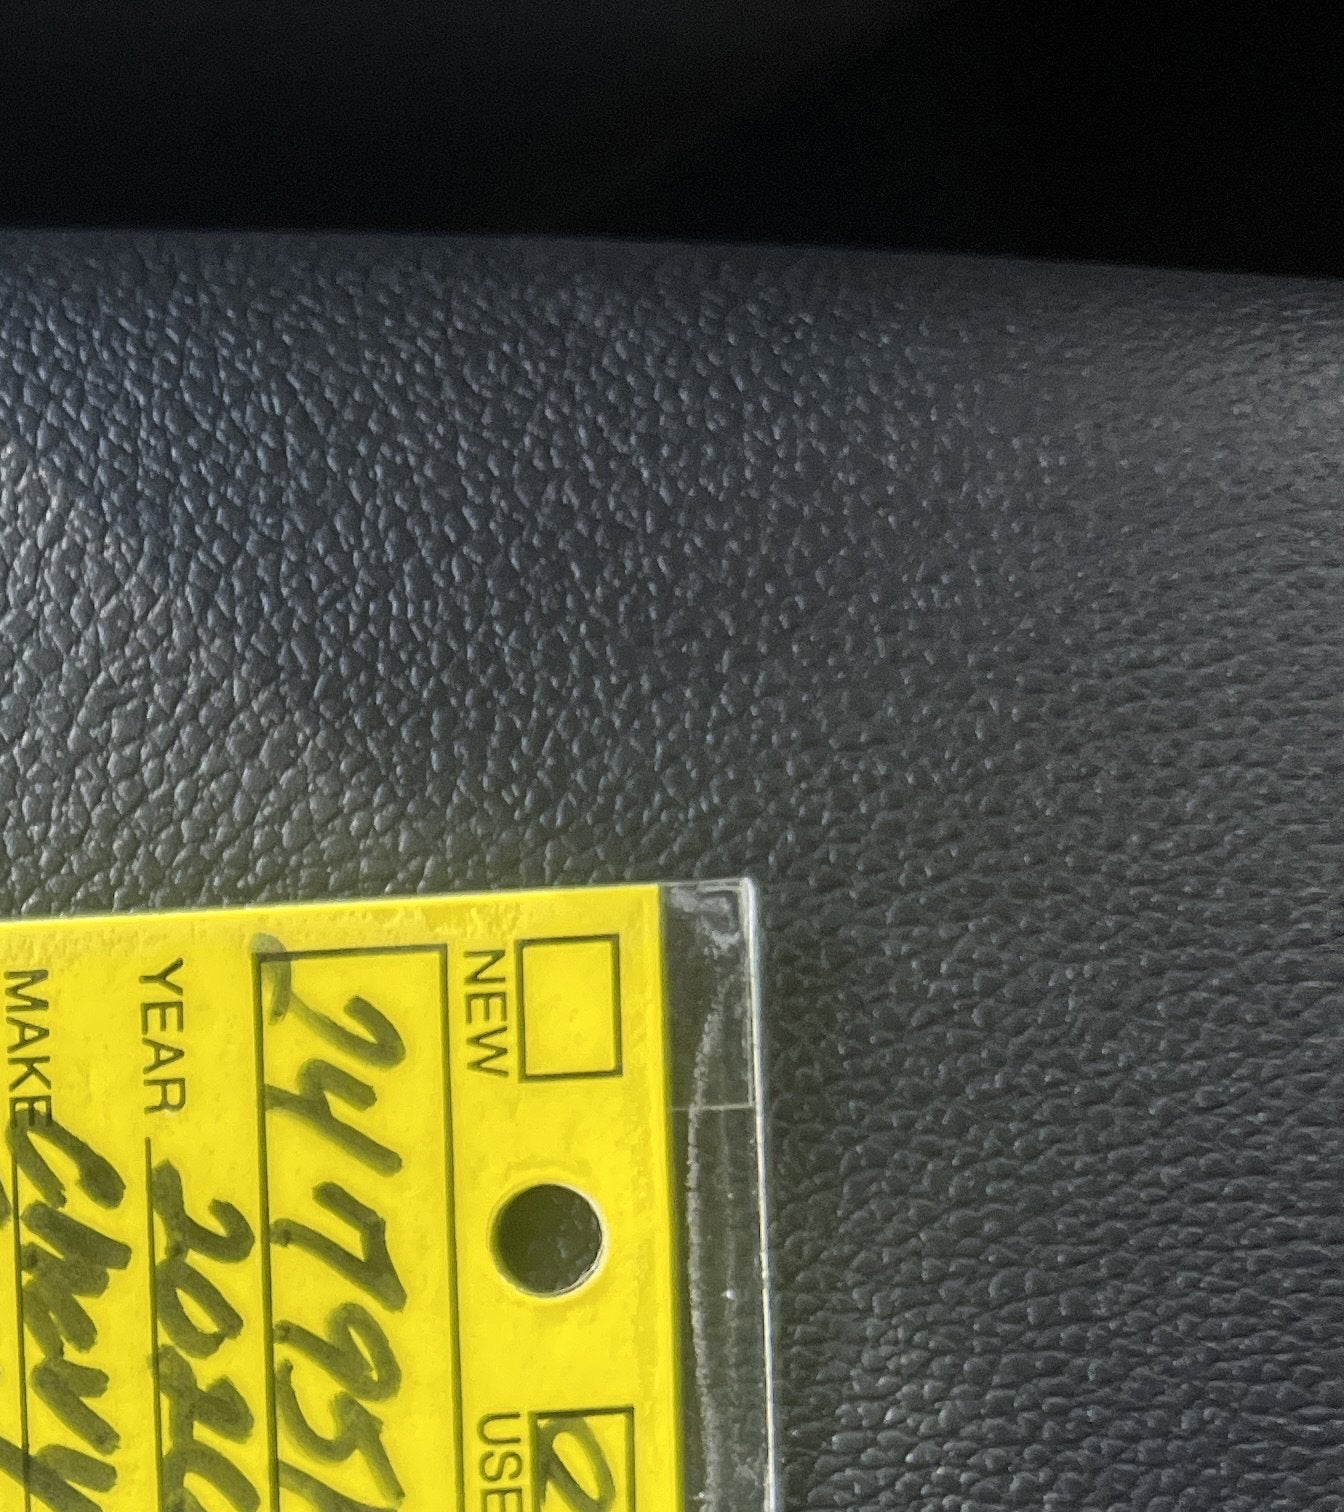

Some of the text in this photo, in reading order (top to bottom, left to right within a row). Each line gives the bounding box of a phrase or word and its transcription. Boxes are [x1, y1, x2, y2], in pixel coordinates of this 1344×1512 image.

[3, 968, 53, 1130] MAKE
[139, 957, 187, 1115] YEAR
[463, 949, 510, 1078] NEW
